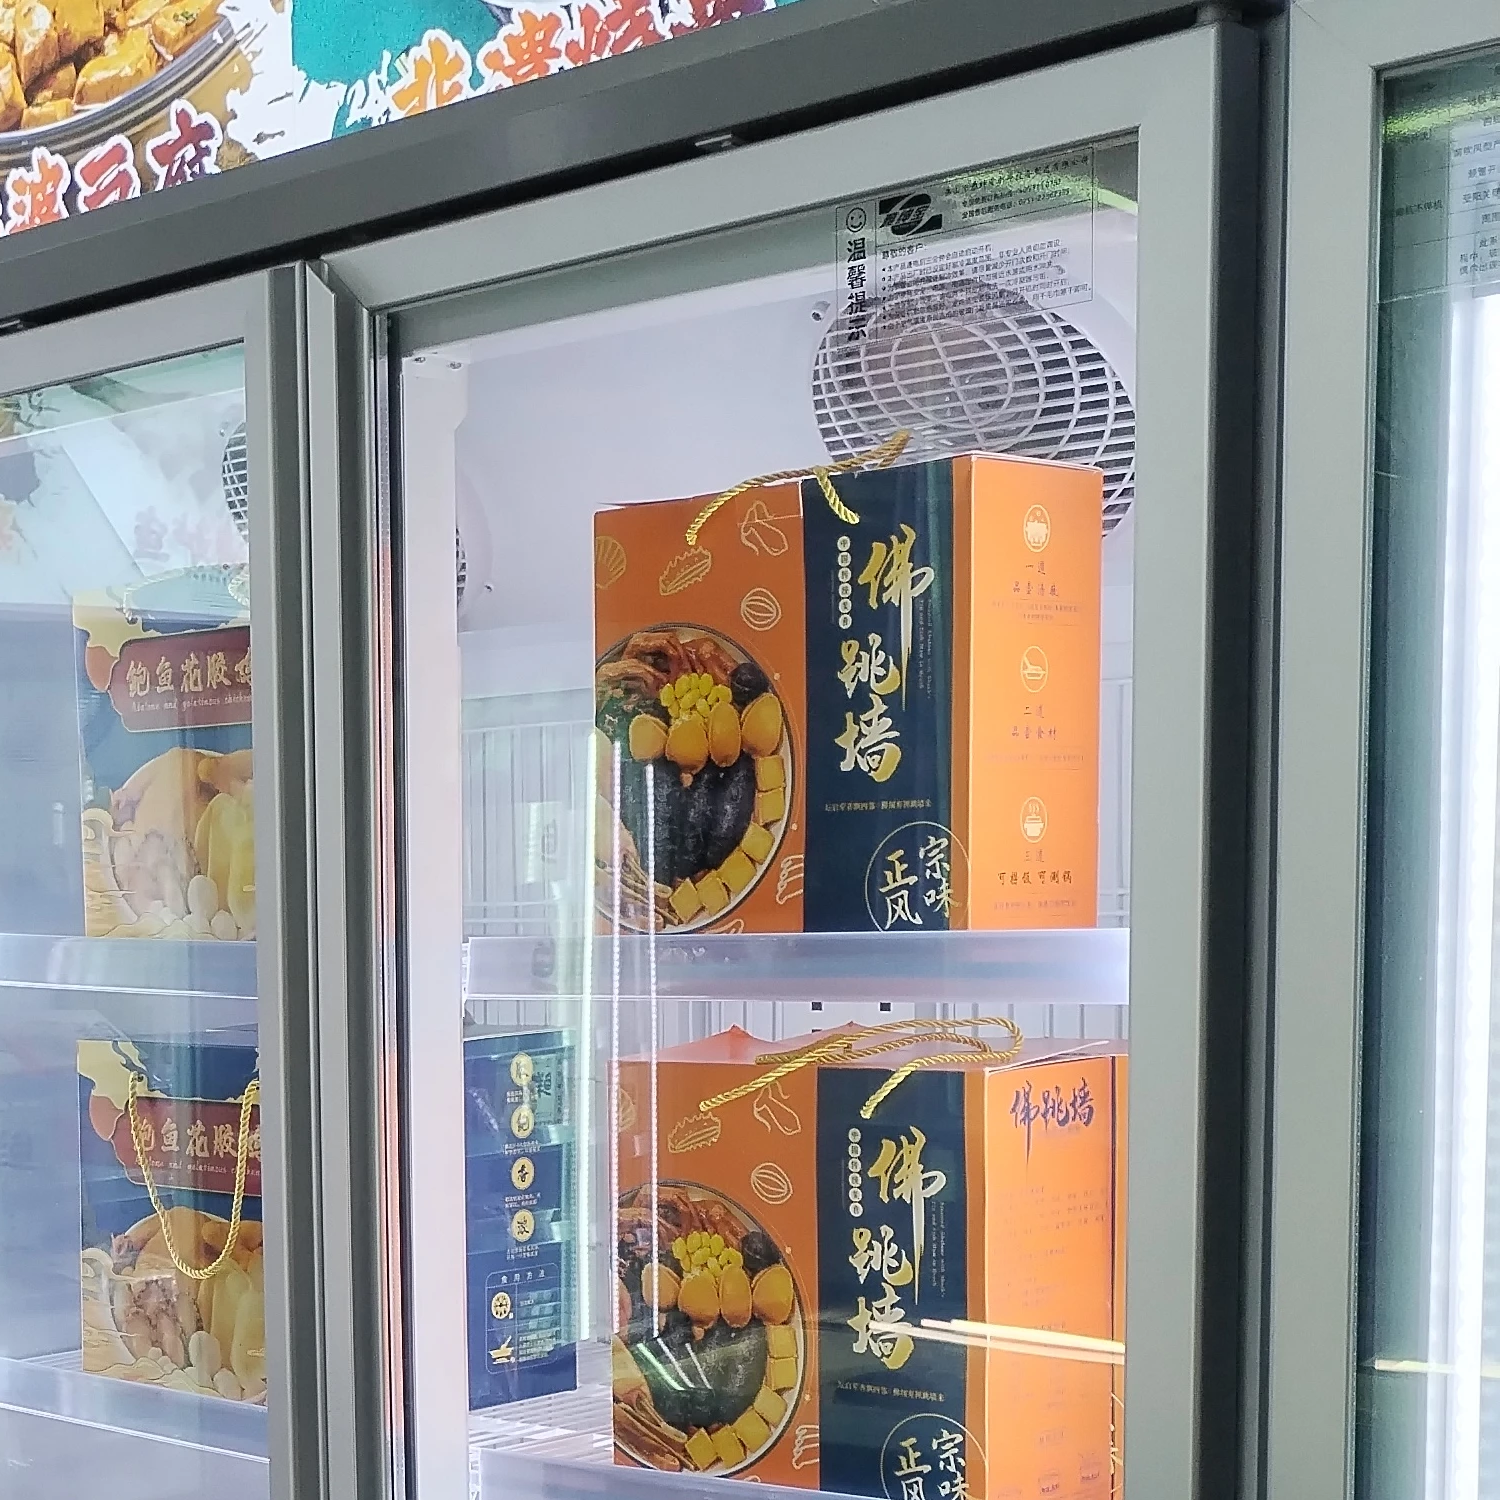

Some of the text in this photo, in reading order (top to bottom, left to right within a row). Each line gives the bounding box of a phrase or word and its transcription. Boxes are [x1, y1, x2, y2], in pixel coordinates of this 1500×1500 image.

[847, 237, 867, 342] 温馨提示
[835, 522, 935, 782] 佛跳墙
[1009, 1079, 1095, 1170] 佛跳墙
[847, 1125, 947, 1370] 佛跳墙
